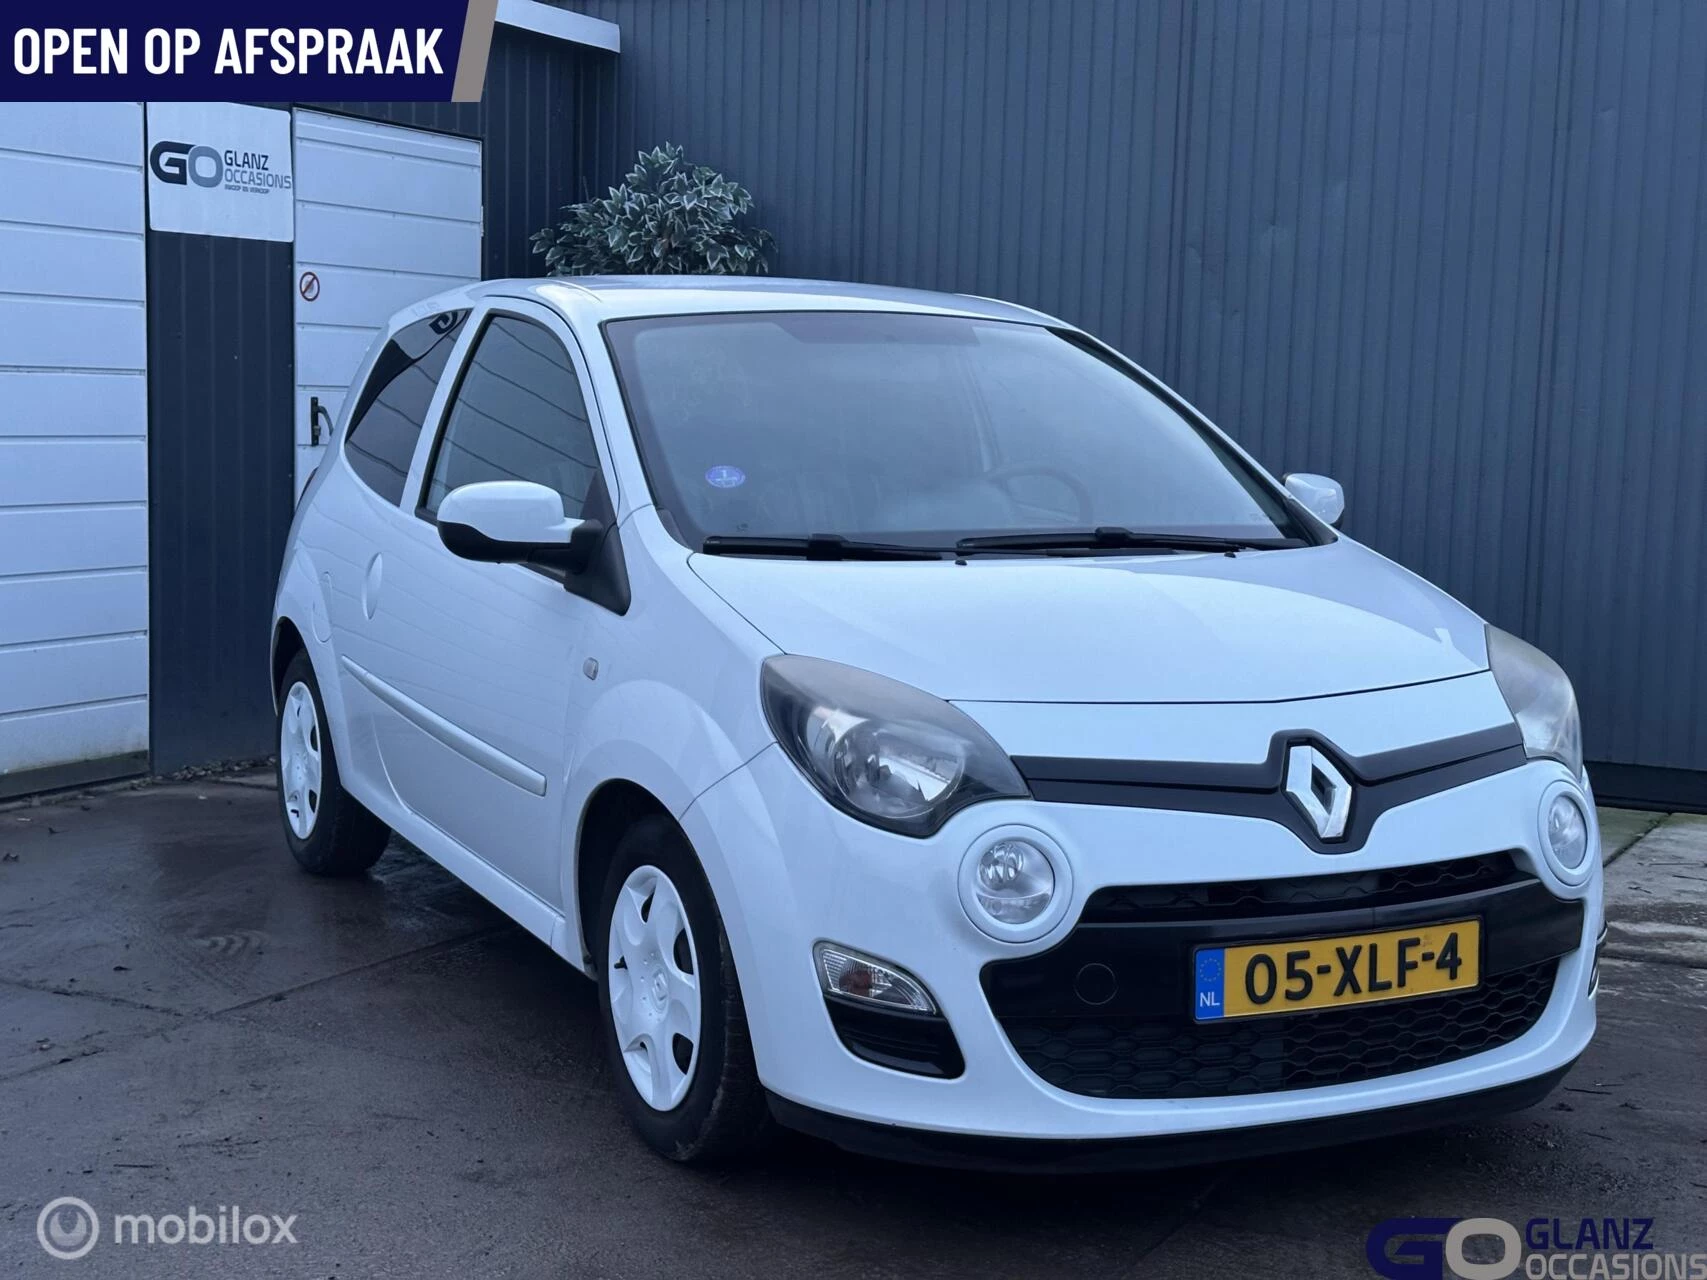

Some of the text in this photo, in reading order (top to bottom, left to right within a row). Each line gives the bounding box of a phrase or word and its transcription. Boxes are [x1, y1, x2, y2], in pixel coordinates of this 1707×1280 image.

[150, 140, 224, 189] GO
[224, 149, 269, 171] GLANZ
[224, 168, 292, 190] OCCASIONS
[1245, 931, 1463, 1005] 05-XLF-4
[1199, 991, 1220, 1008] NL
